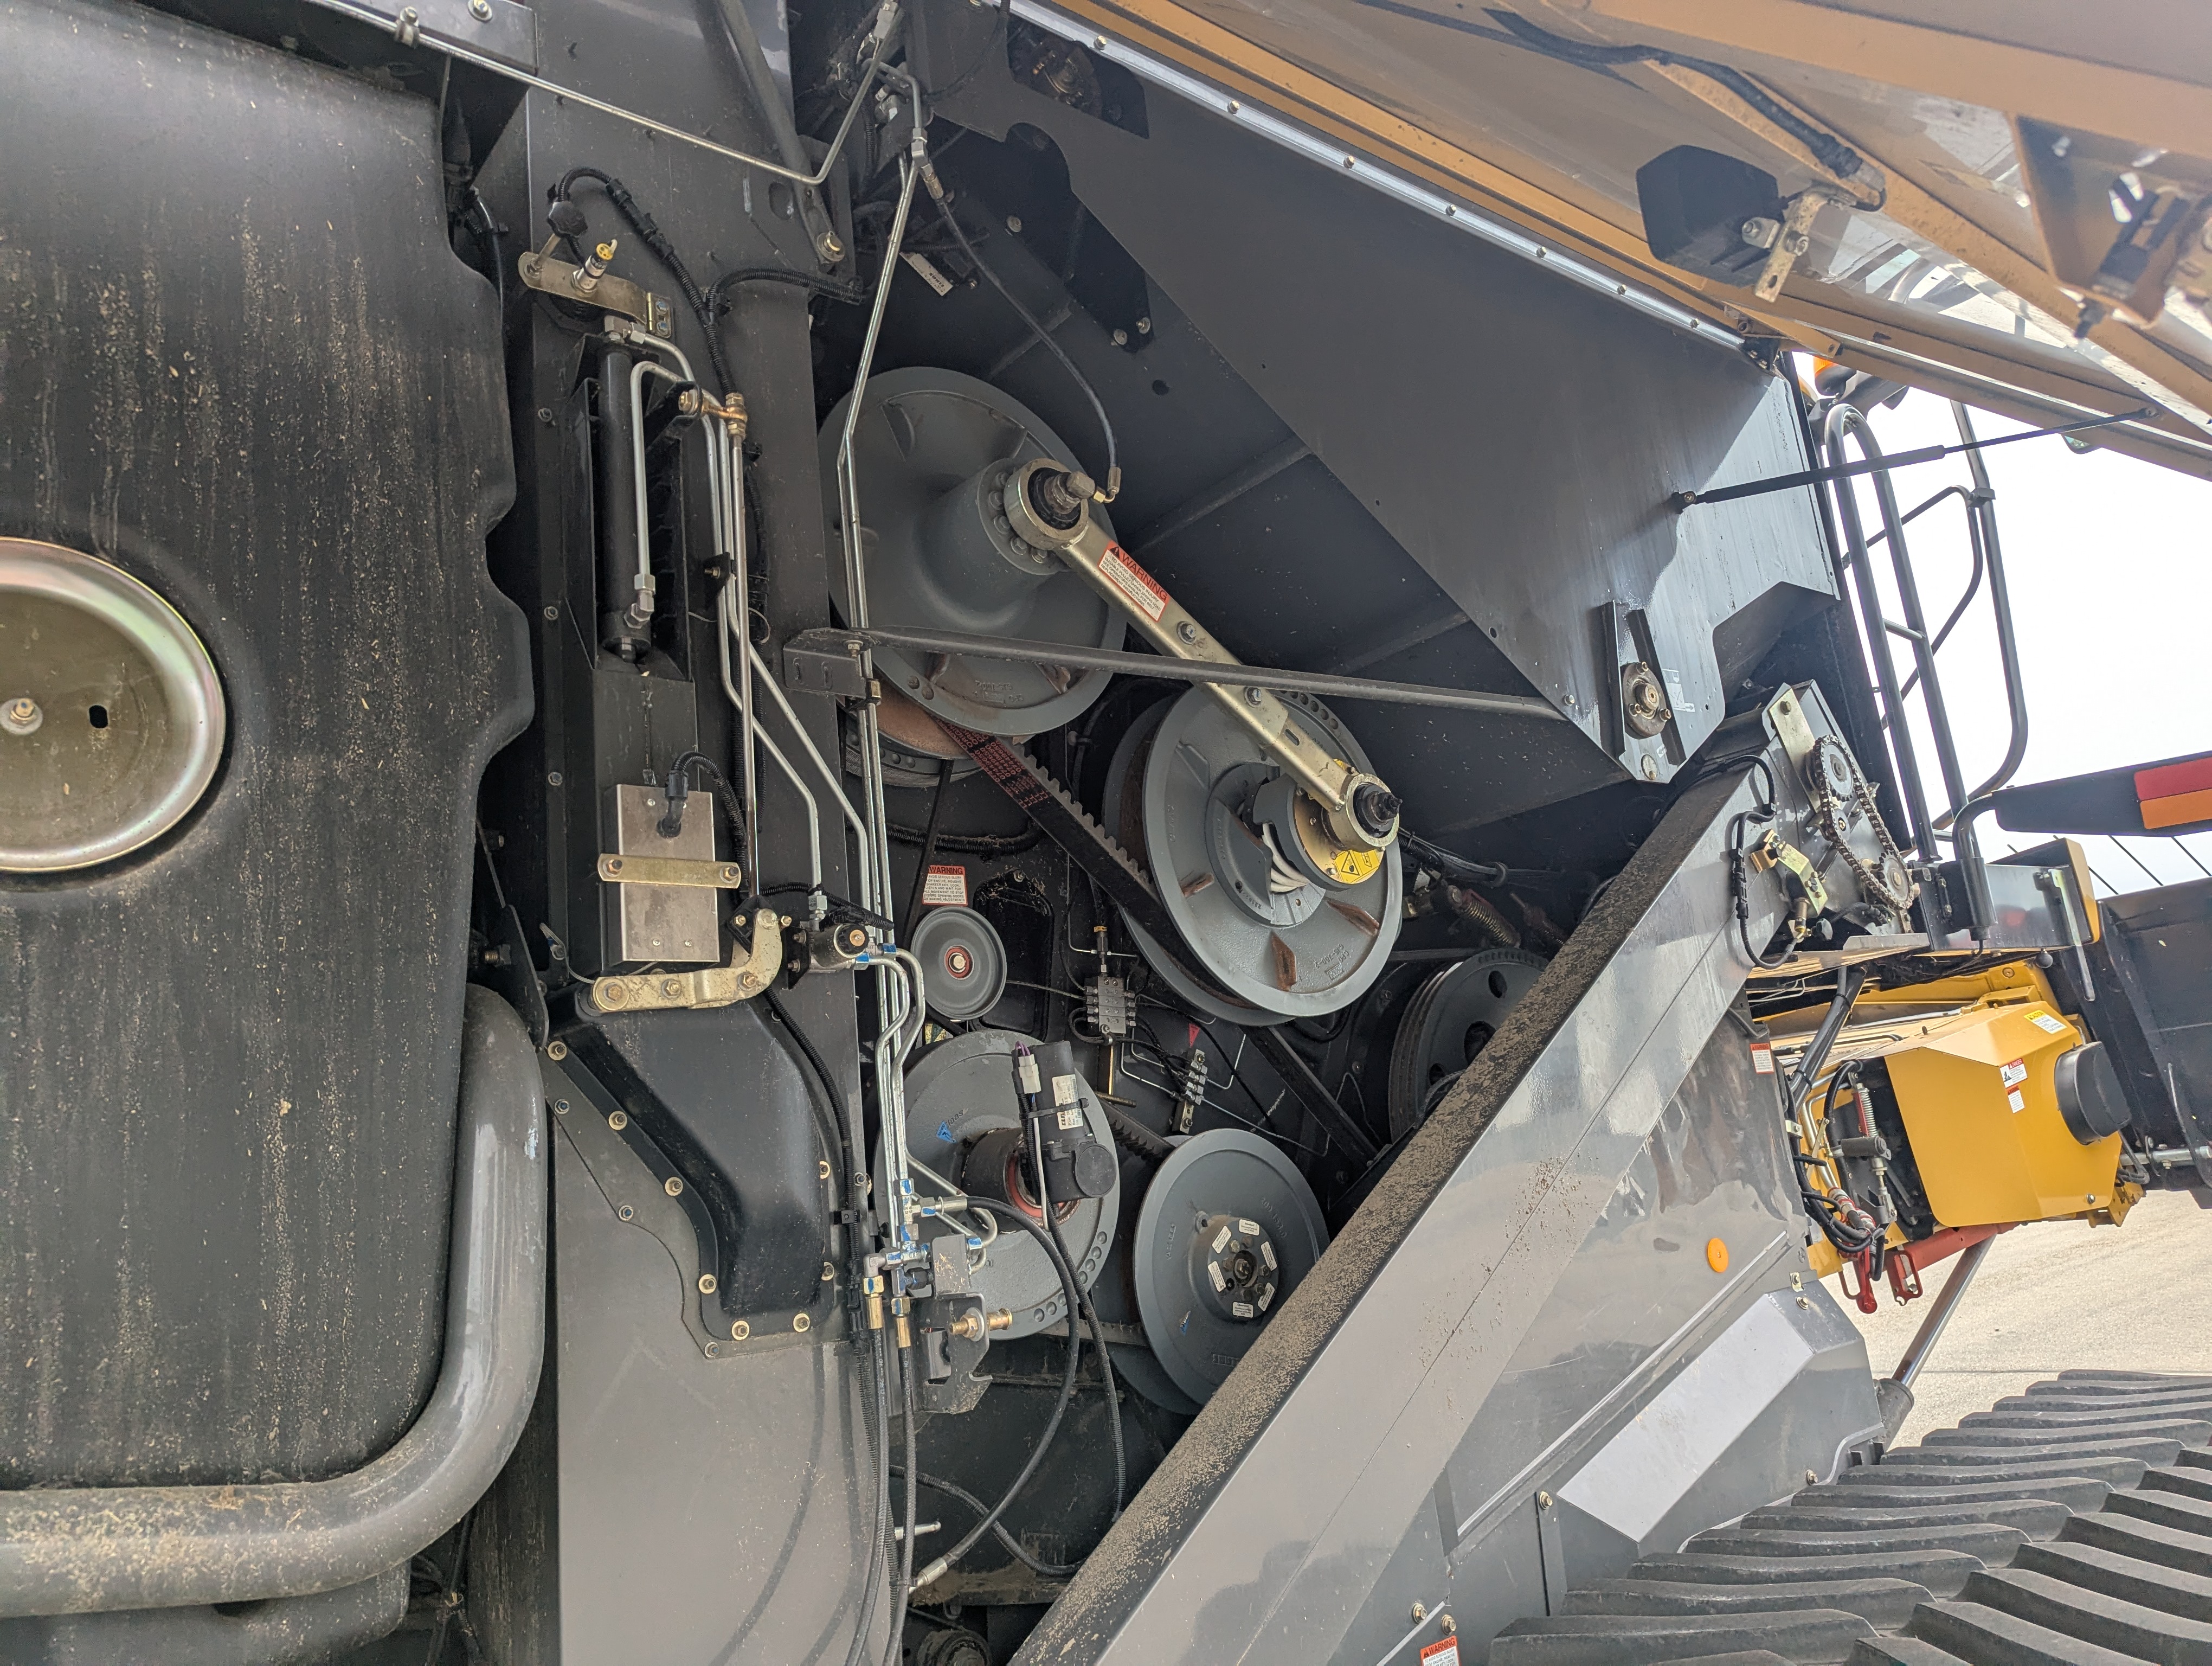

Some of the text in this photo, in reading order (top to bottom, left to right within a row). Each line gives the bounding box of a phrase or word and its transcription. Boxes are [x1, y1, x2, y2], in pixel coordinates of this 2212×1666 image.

[1099, 563, 1123, 586] REPLACEMENT
[1103, 556, 1119, 571] VARIABLE
[1118, 570, 1131, 582] PULLEY
[1129, 581, 1142, 592] UNDER
[1140, 591, 1153, 604] SPRING
[1116, 562, 1129, 574] AVOID
[1128, 573, 1146, 590] SERIOUS
[1144, 588, 1159, 603] INJURY
[1122, 553, 1167, 601] WARNING
[1127, 584, 1141, 597] MANUAL
[1146, 601, 1154, 610] BELT
[929, 866, 963, 874] WARNING
[1429, 1637, 1455, 1655] WARNING
